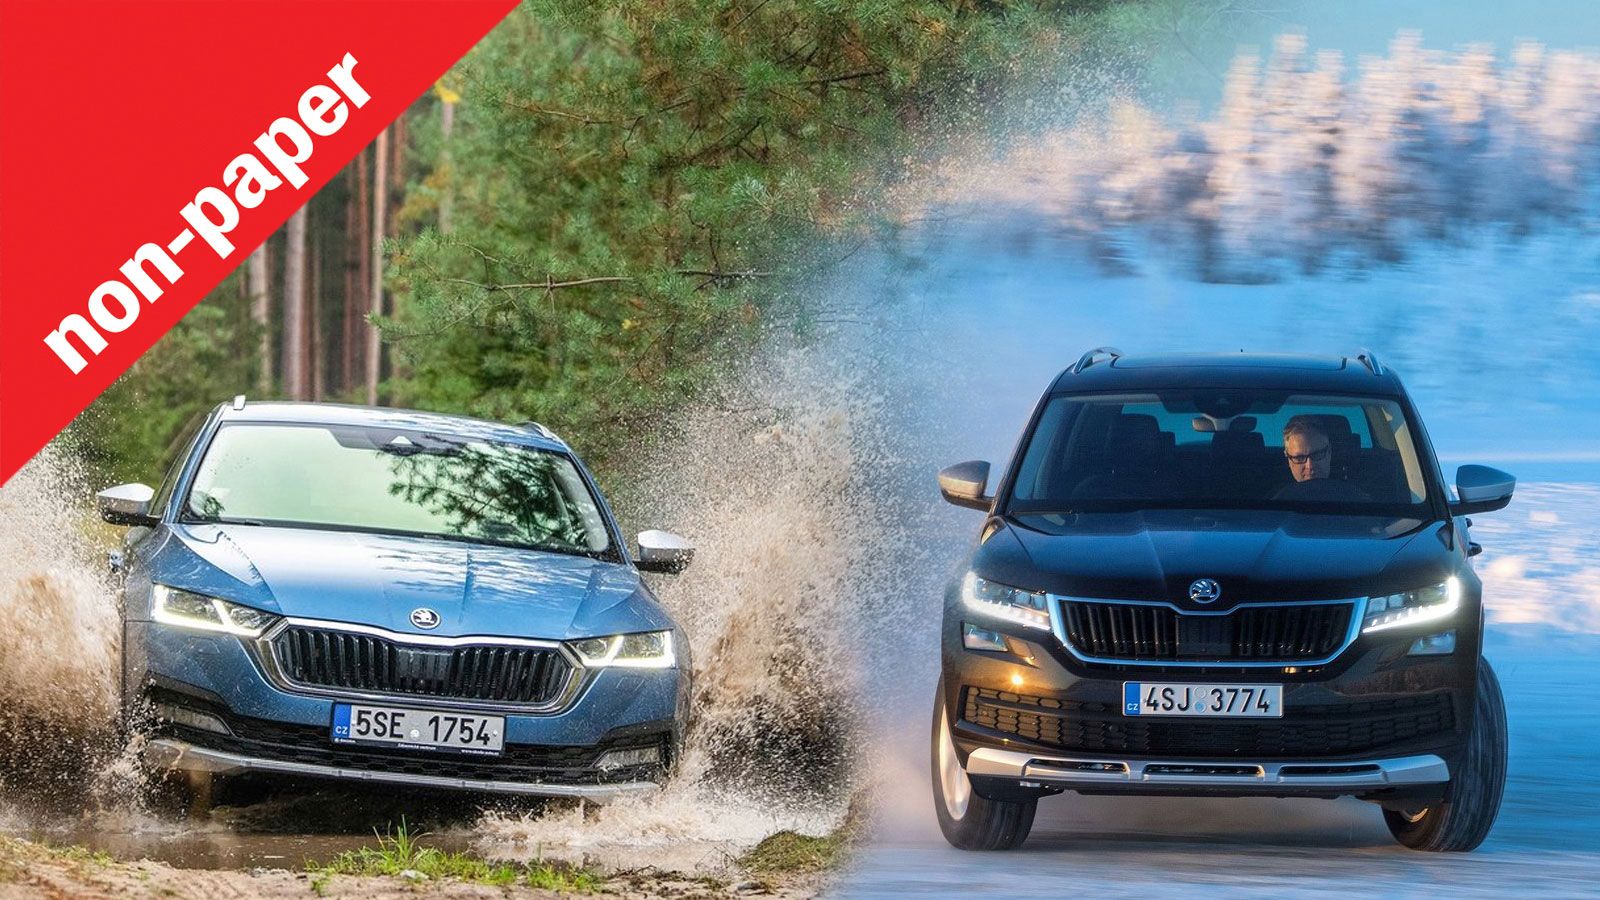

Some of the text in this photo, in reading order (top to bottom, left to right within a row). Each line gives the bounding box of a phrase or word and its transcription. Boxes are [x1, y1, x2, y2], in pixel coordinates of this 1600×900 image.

[1127, 703, 1139, 711] CZ
[1145, 687, 1270, 713] 4SJ 3774
[335, 725, 348, 735] CZ
[356, 709, 490, 745] 5SE 1754
